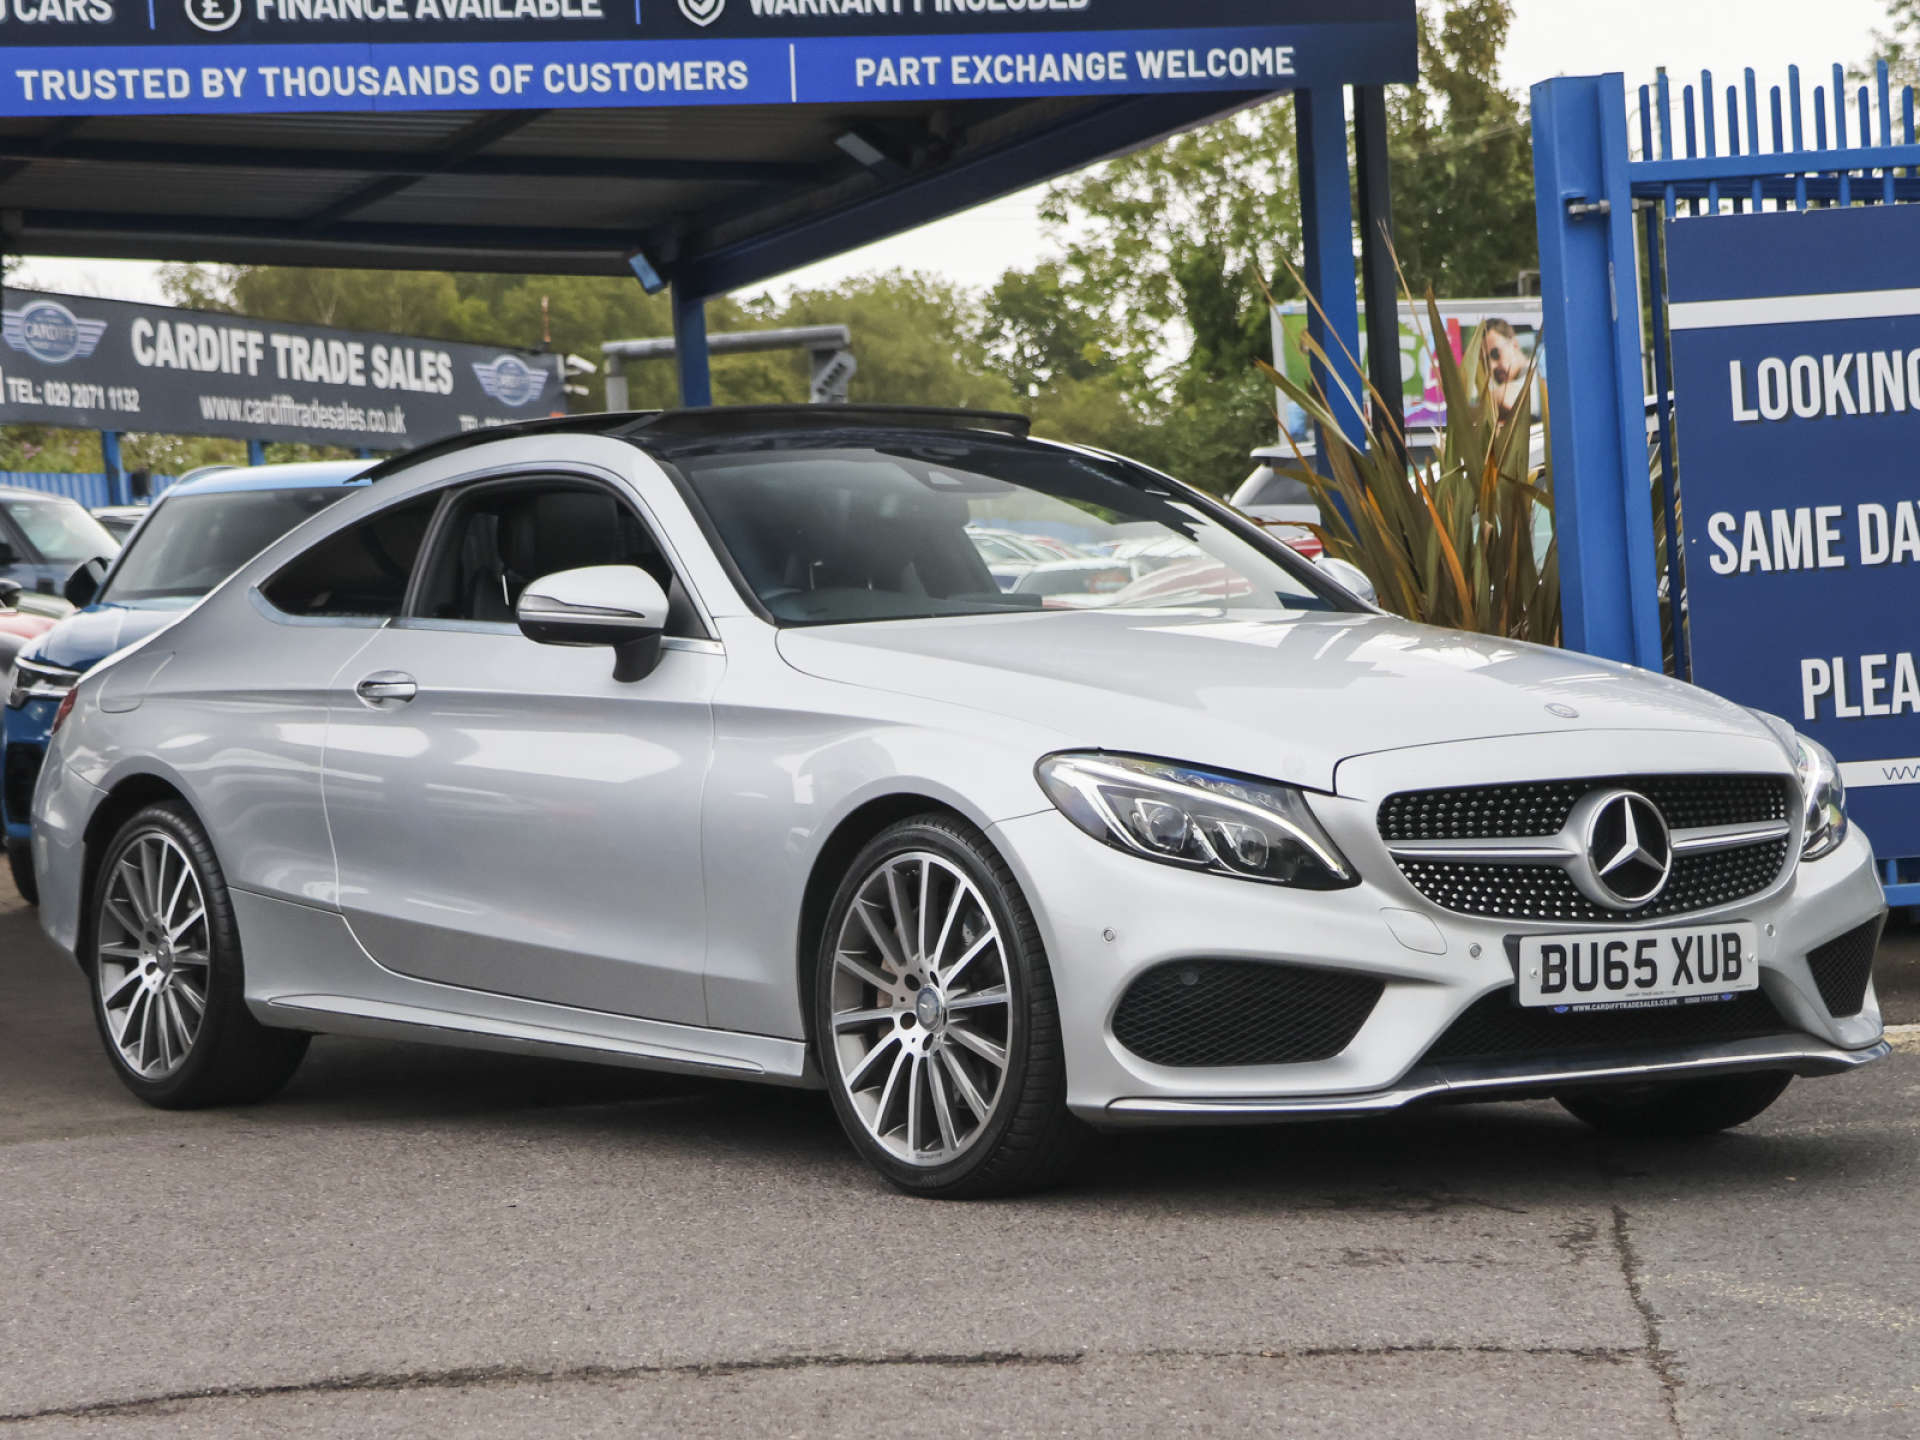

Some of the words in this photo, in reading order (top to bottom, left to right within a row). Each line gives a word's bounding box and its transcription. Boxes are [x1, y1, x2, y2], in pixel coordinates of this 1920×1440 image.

[16, 68, 190, 101] TRUSTED
[201, 67, 247, 98] BY
[258, 64, 480, 97] THOUSANDS
[489, 64, 534, 95] OF
[543, 60, 748, 94] CUSTOMERS
[855, 56, 942, 87] PART
[951, 50, 1127, 85] EXCHANGE
[1135, 46, 1295, 79] WELCOME
[131, 317, 264, 377] CARDIFF
[270, 332, 367, 386] TRADE
[371, 344, 454, 395] SALES
[6, 376, 42, 406] TEL:
[43, 380, 71, 407] 029
[71, 383, 105, 410] 2071
[107, 386, 140, 412] 1132
[200, 394, 407, 434] www.cardifftradesales.co.uk
[1707, 504, 1845, 575] SAME
[1857, 500, 1920, 566] DA
[1540, 938, 1658, 995] BU65
[1671, 931, 1742, 986] XUB
